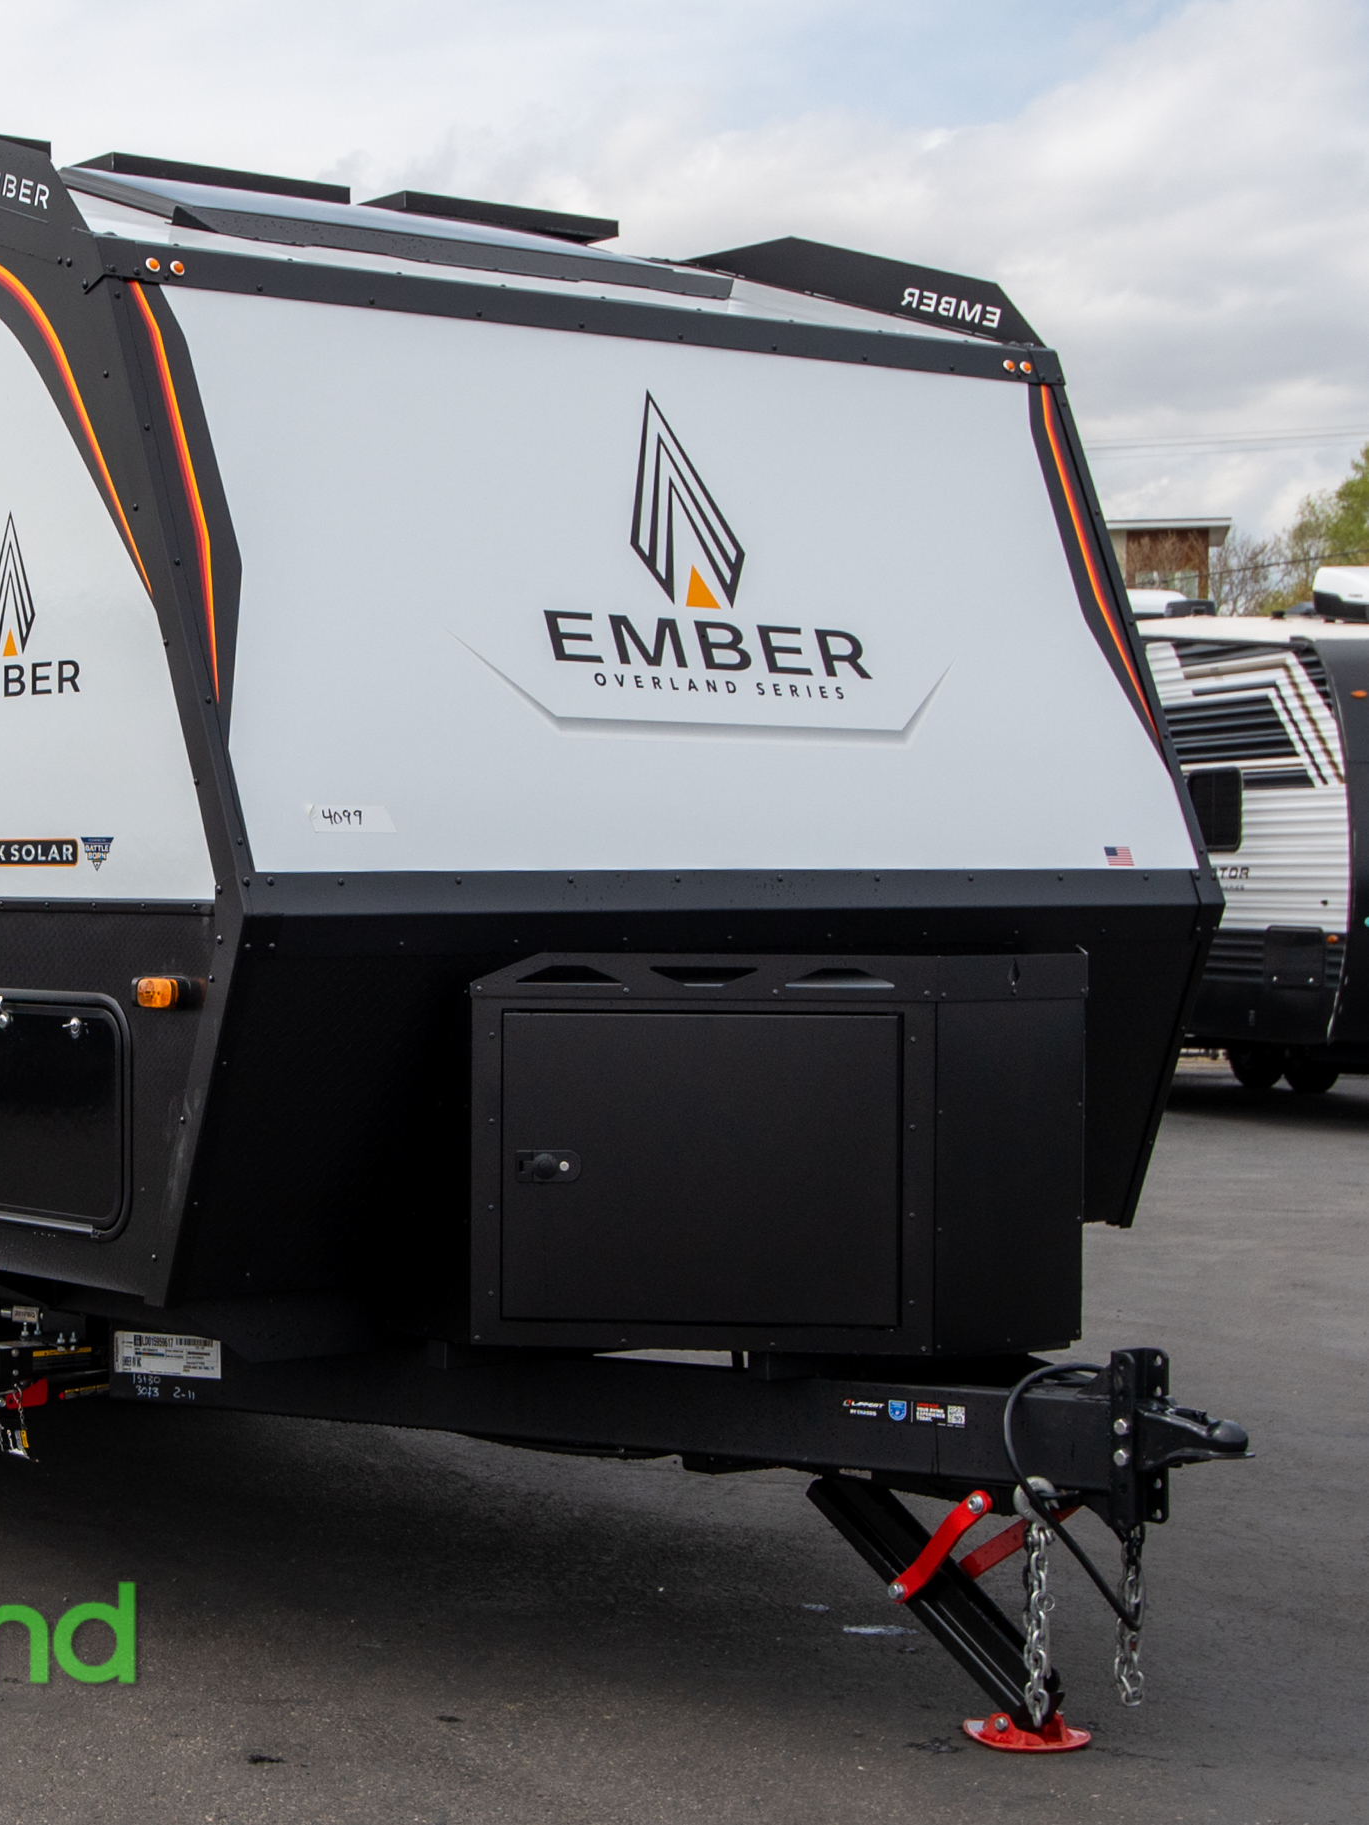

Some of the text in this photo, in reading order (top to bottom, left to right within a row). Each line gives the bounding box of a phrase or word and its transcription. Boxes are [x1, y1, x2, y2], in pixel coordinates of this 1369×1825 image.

[543, 609, 873, 680] EMBER
[593, 672, 845, 700] OVERLAND SERIES
[321, 808, 362, 826] 4099
[10, 844, 74, 862] SOLAR
